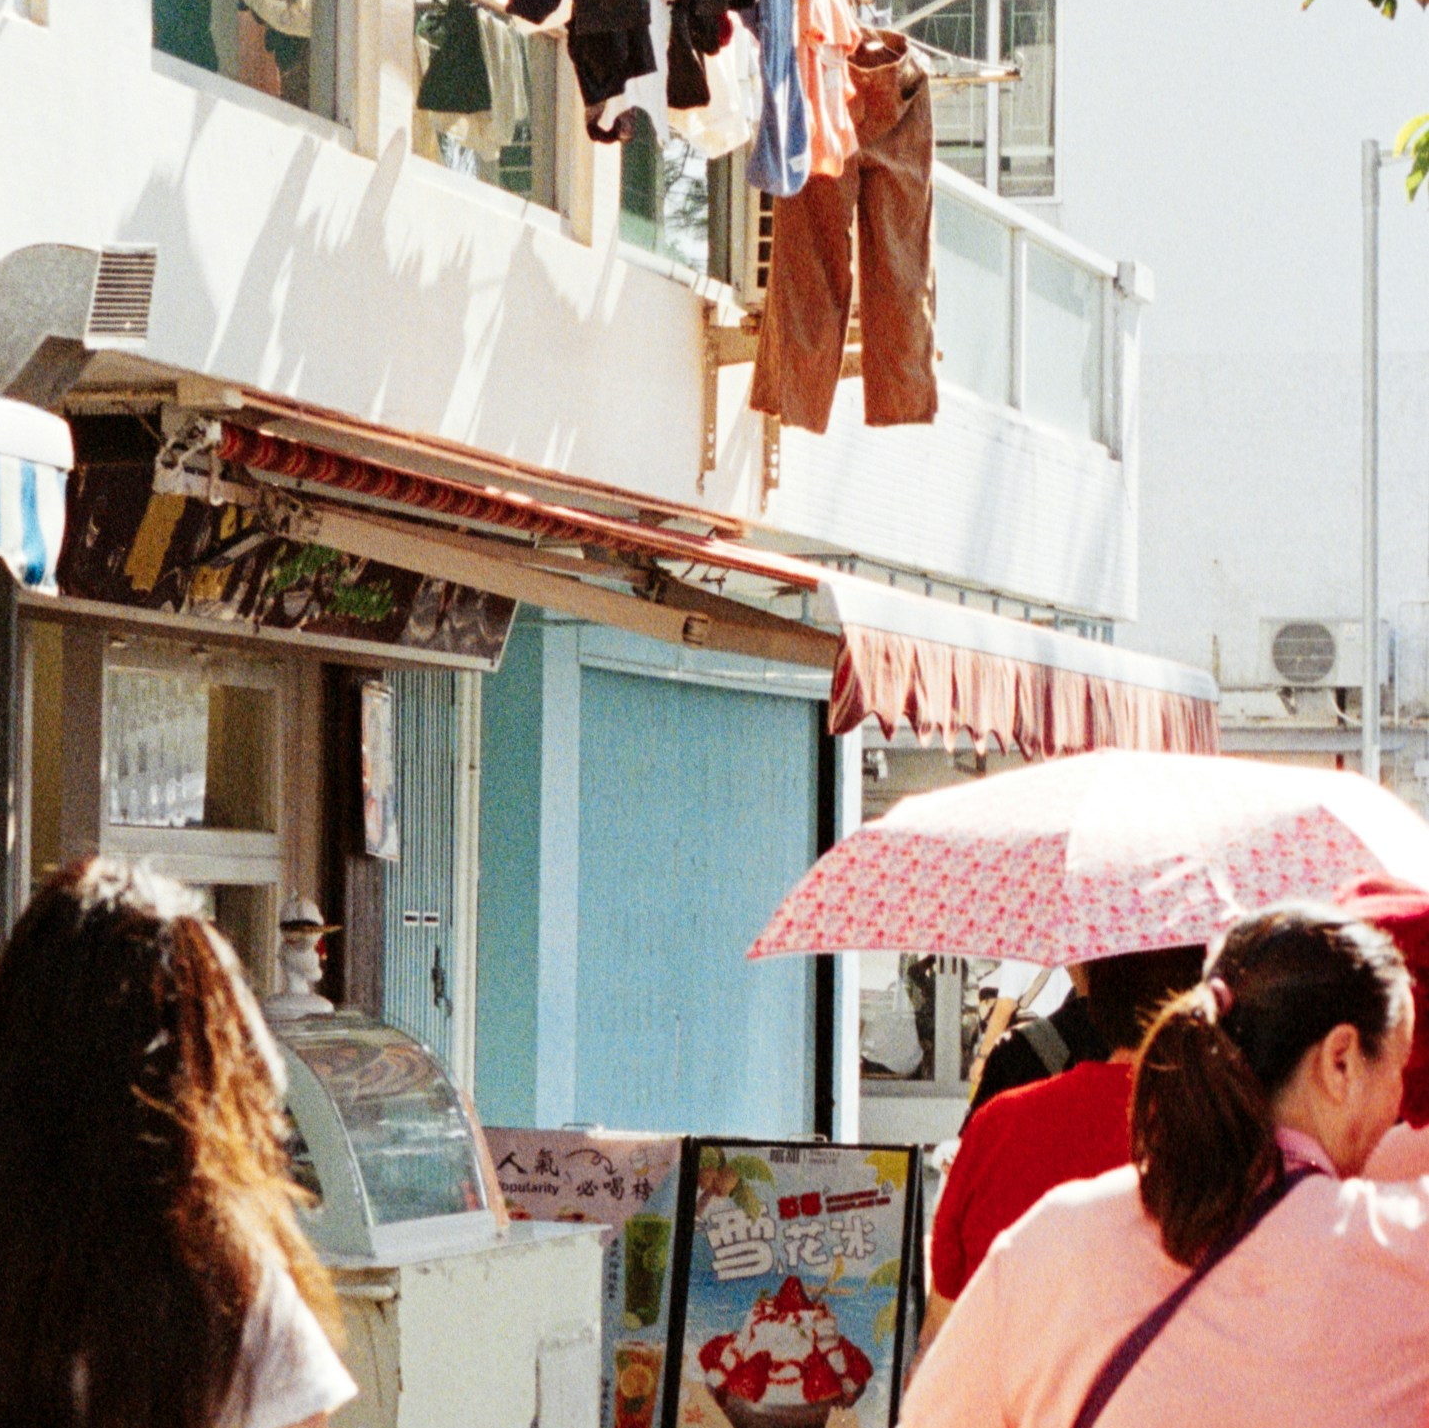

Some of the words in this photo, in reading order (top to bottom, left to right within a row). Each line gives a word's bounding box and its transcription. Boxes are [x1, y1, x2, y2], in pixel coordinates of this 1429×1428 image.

[497, 1148, 560, 1177] 人氣
[500, 1181, 560, 1197] opularity
[706, 1205, 877, 1281] 雪花冰
